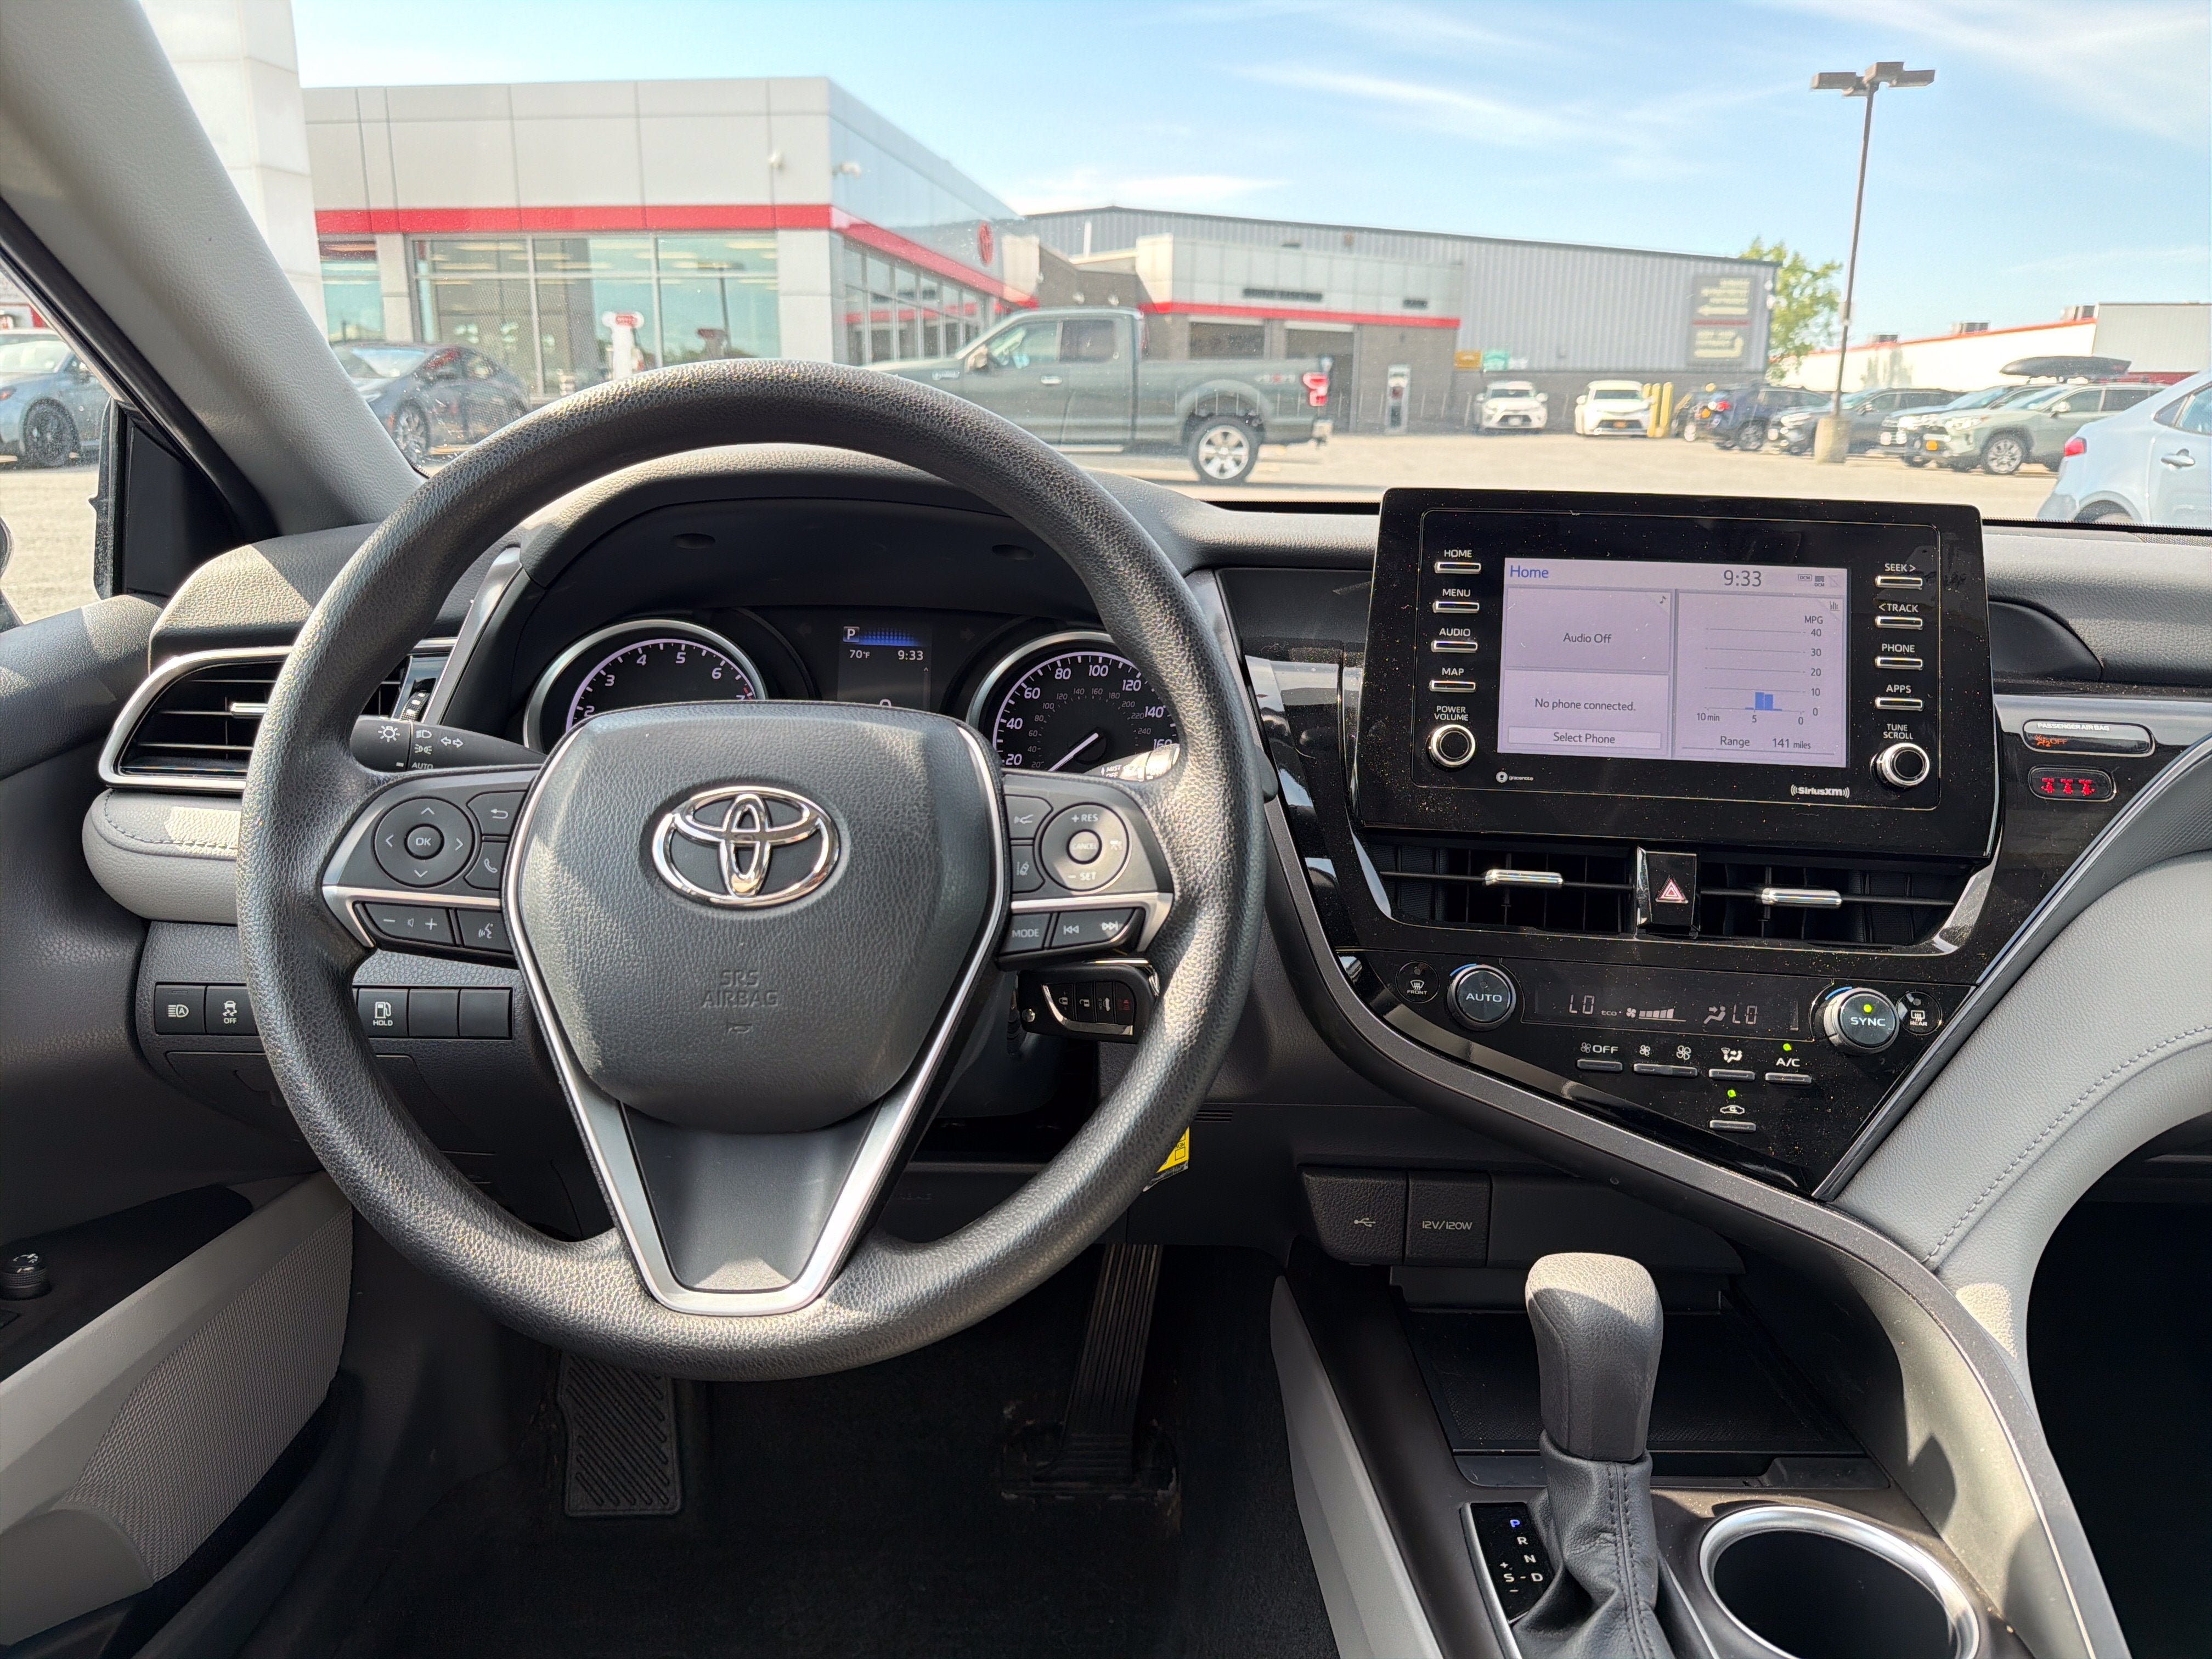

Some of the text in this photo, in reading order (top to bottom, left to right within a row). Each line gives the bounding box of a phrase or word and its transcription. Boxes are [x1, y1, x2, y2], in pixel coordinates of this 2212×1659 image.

[1444, 550, 1472, 558] HOME
[1510, 566, 1549, 579] Home
[1724, 570, 1762, 587] 9:33
[1442, 589, 1471, 597] MENU
[1804, 616, 1824, 624] MPG
[1439, 628, 1471, 636] AUDIO
[1810, 629, 1822, 637] 40
[1563, 633, 1611, 644] Audio Off
[1810, 648, 1821, 657] 30
[1882, 644, 1915, 653] PHONE
[636, 654, 647, 666] 4
[675, 652, 686, 664] 5
[898, 650, 923, 661] 9:33
[712, 667, 722, 679] 6
[1054, 668, 1071, 680] 80
[1088, 664, 1109, 677] 100
[1442, 668, 1464, 676] MAP
[1810, 668, 1821, 676] 20
[605, 675, 616, 686] 3
[1122, 679, 1142, 692] 120
[1024, 687, 1041, 699] 60
[1811, 688, 1820, 696] 10
[1886, 685, 1911, 693] APPS
[1535, 699, 1637, 712] No phone connected.
[584, 706, 595, 716] 2
[1144, 706, 1164, 718] 140
[1812, 708, 1818, 716] 0
[1006, 718, 1023, 730] 40
[1752, 715, 1757, 723] 5
[1887, 723, 1908, 731] TUNE
[1553, 732, 1615, 744] Select Phone
[1883, 731, 1914, 740] SCROLL
[1720, 736, 1811, 749] Range 141 miles
[1006, 754, 1022, 766] 20
[1081, 813, 1098, 822] RES
[415, 838, 431, 847] OK
[1080, 871, 1097, 881] SET
[1012, 929, 1039, 938] MODE
[720, 969, 759, 988] SRS
[702, 990, 779, 1008] AIRBAG
[1466, 992, 1502, 1003] AUTO
[1850, 1017, 1886, 1027] SYNC
[1593, 1045, 1618, 1054] OFF
[1776, 1057, 1801, 1068] A/C
[1422, 1220, 1473, 1230] 12V/120W
[1510, 1519, 1520, 1528] P
[1516, 1537, 1528, 1545] R
[1523, 1554, 1536, 1563] N
[1503, 1573, 1515, 1582] S
[1531, 1573, 1543, 1582] D
